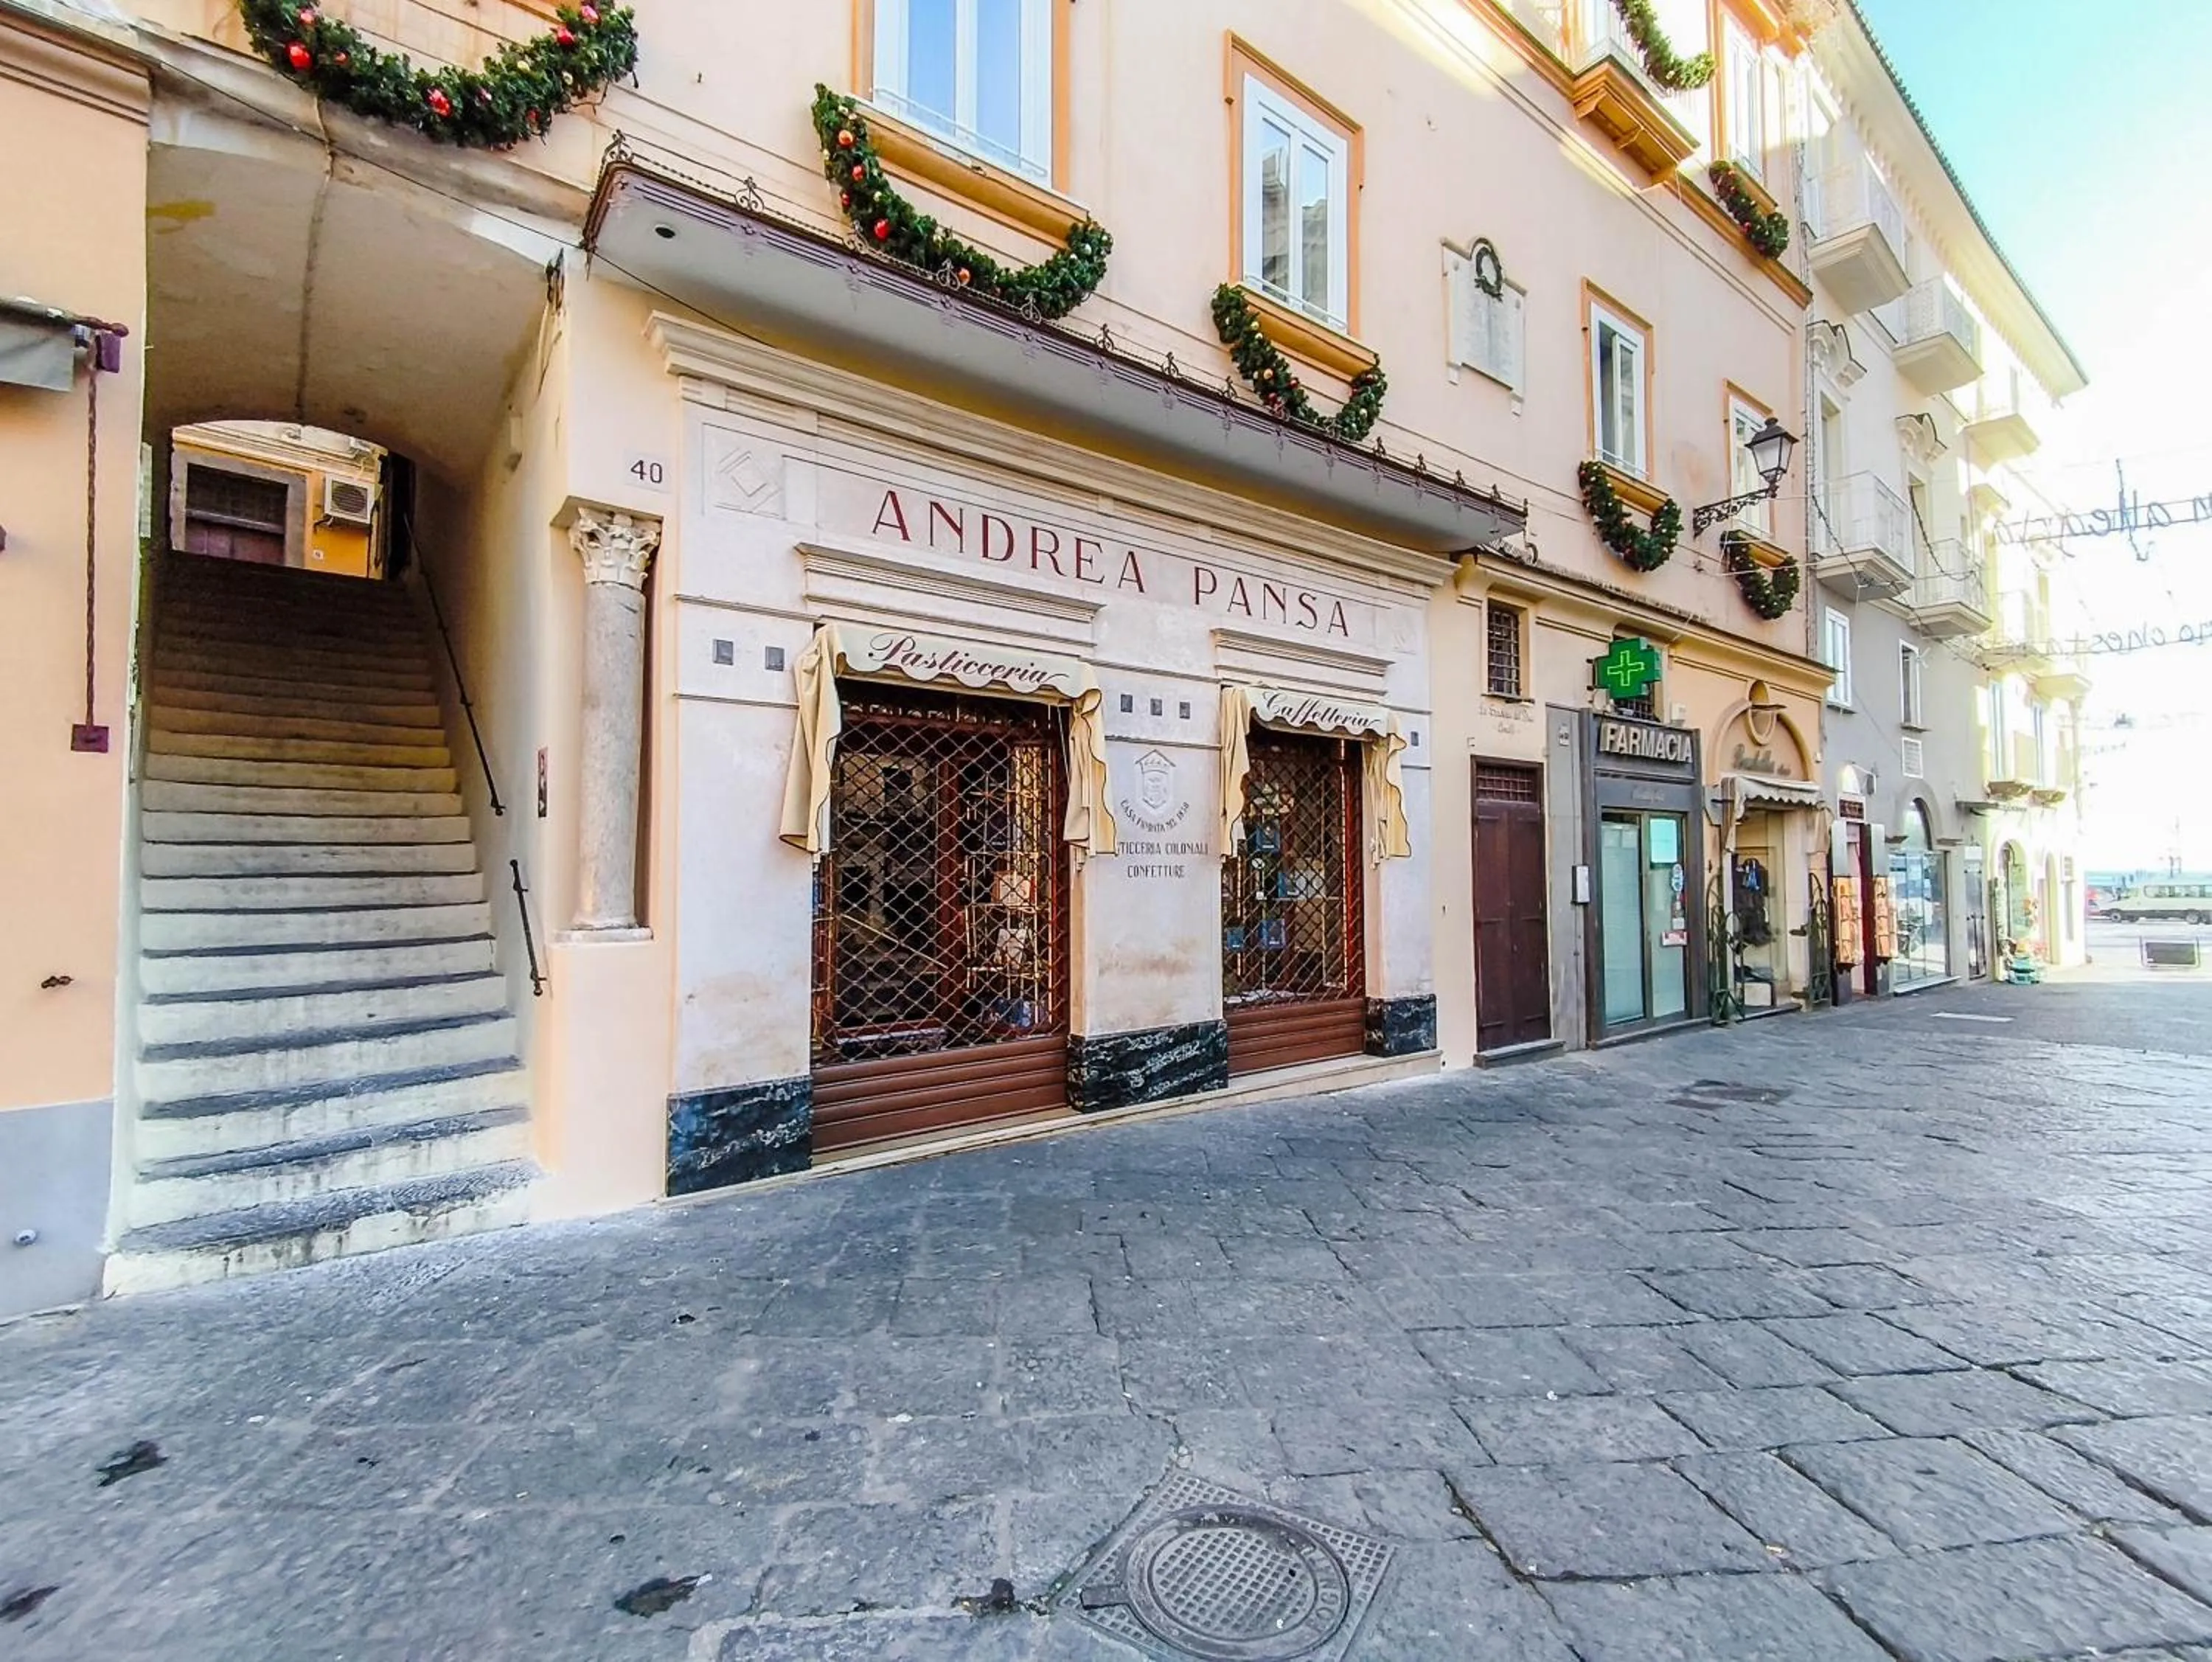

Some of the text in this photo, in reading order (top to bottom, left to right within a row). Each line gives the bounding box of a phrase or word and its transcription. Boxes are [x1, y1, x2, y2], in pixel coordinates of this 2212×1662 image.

[630, 459, 663, 484] 40
[872, 490, 1349, 637] ANDREA PANSA
[868, 632, 1070, 684] Pasticceria
[1262, 691, 1381, 726] Caffetteria
[1601, 722, 1694, 763] FARMACIA
[1117, 841, 1161, 855] TICCERIA
[1127, 865, 1186, 878] CONFETTURE
